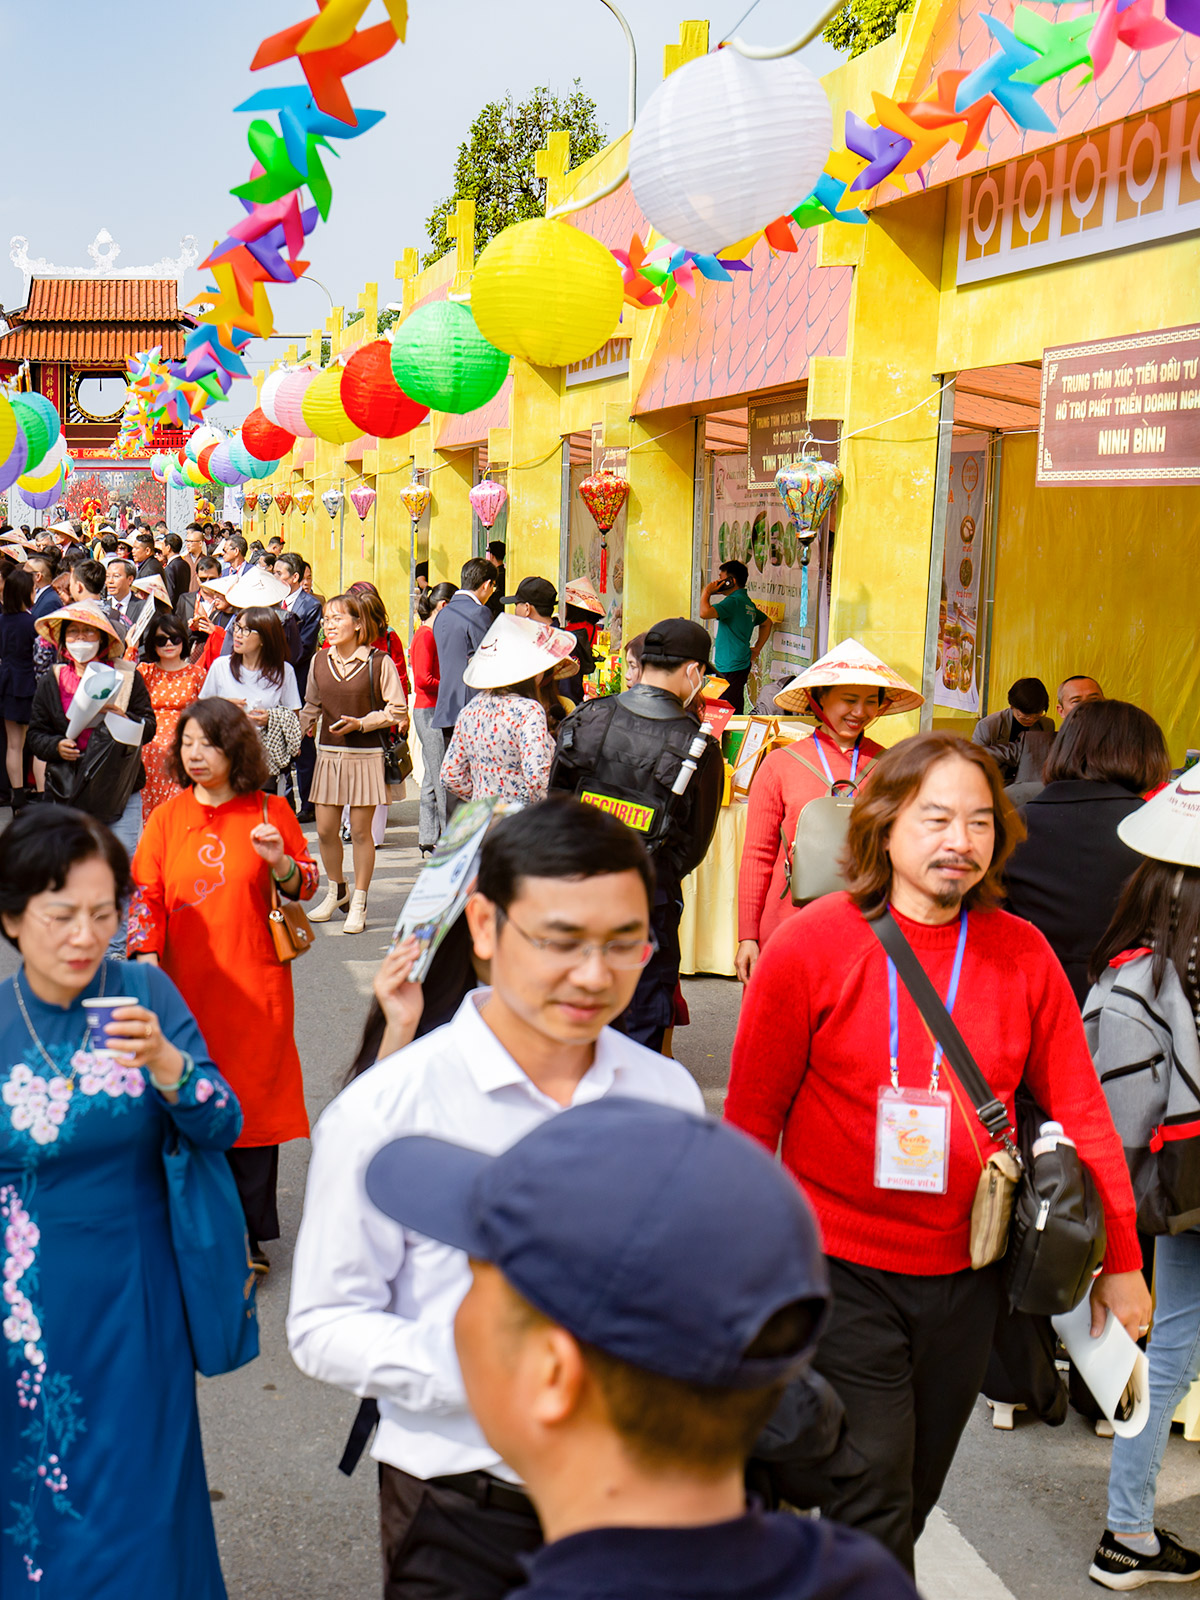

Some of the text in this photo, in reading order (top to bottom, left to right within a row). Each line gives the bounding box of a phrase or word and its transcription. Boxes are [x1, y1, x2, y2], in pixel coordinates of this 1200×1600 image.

[1062, 356, 1199, 394] TRUNG TÂM XÚC TIẾN ĐẦU TƯ
[1055, 400, 1070, 421] HỖ
[1069, 399, 1087, 422] TRỢ
[1088, 393, 1113, 418] PHÁT
[1114, 388, 1142, 416] TRIỂN
[1143, 392, 1178, 413] DOANH
[1098, 418, 1167, 455] NINH BÌNH
[582, 794, 651, 828] SECURITY
[1097, 1545, 1140, 1568] ASHION
